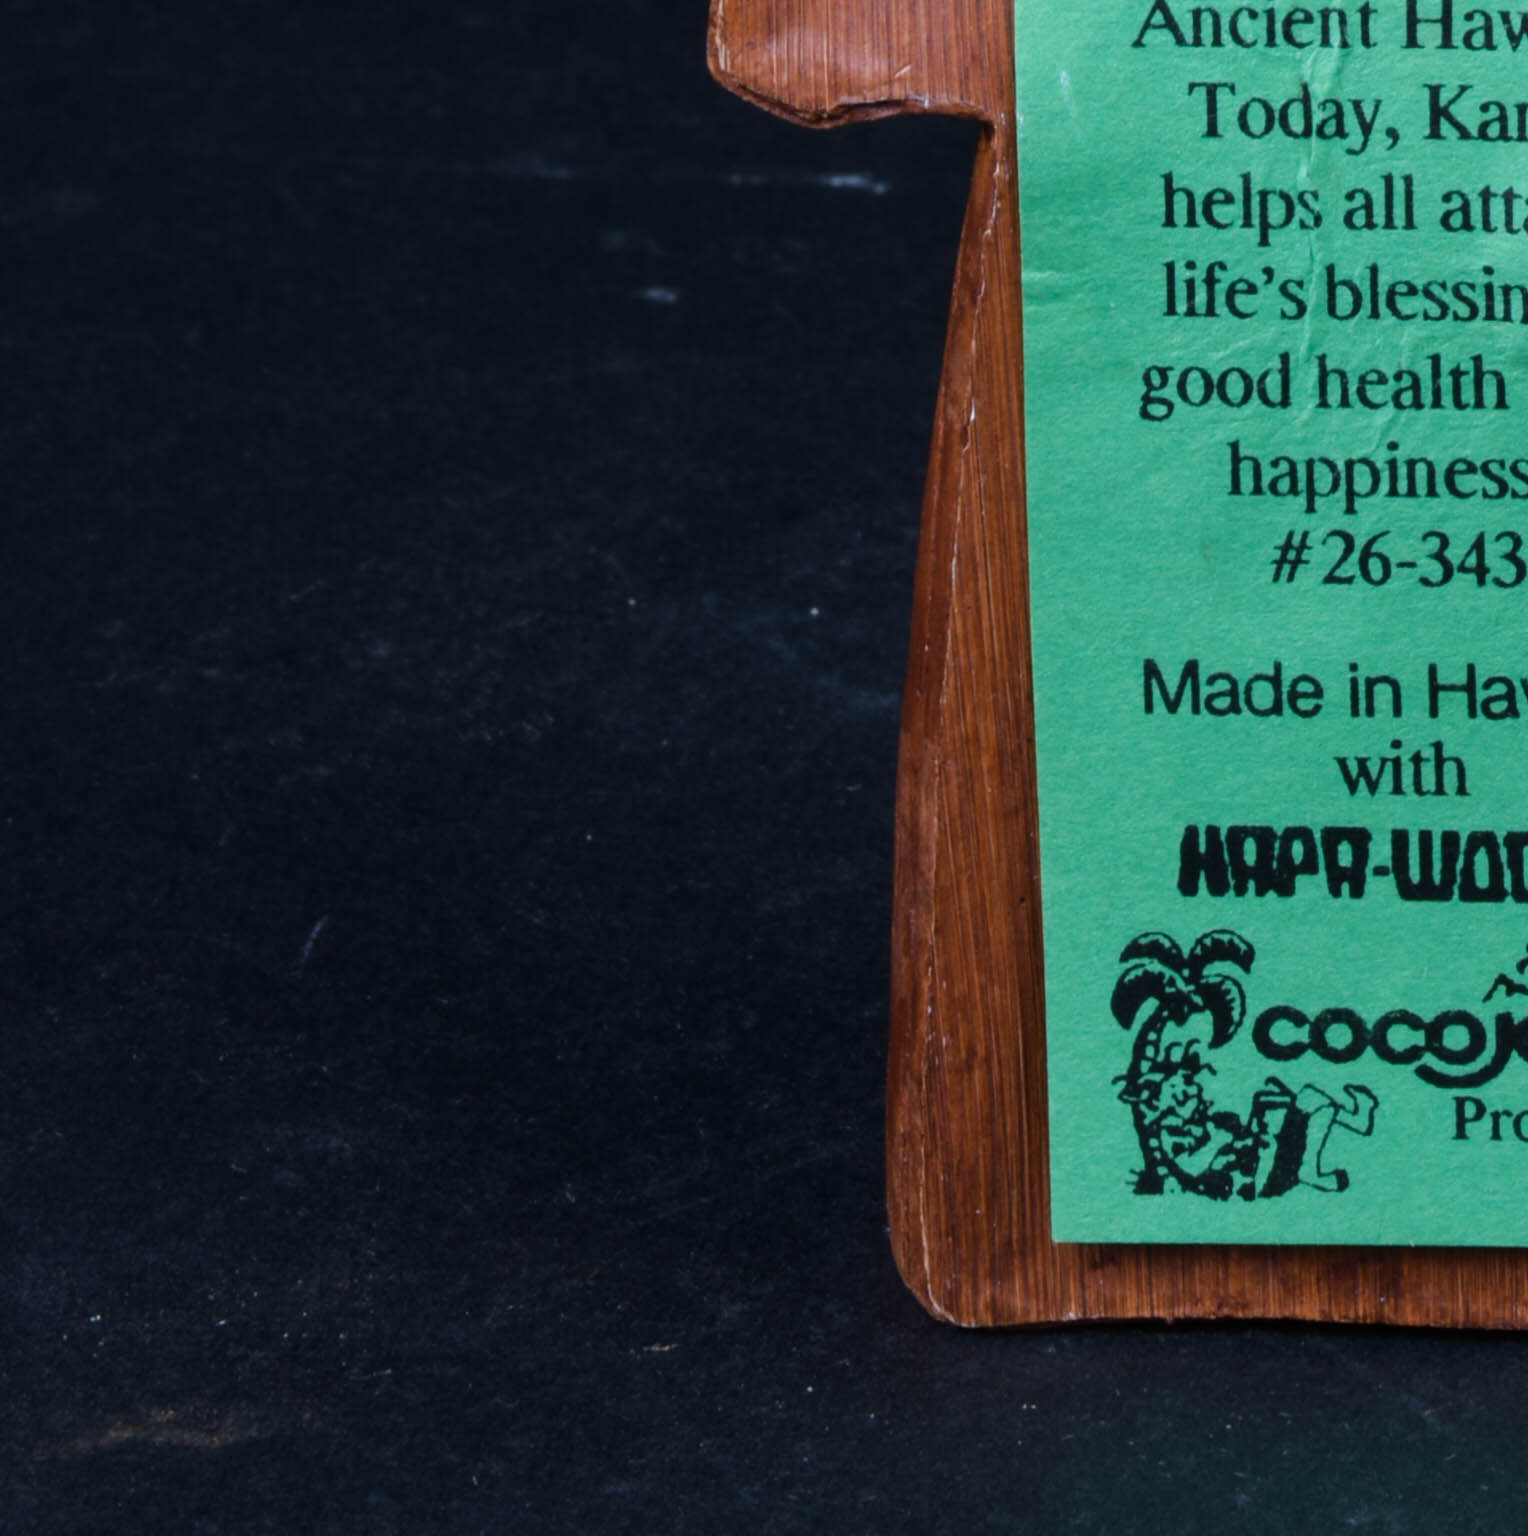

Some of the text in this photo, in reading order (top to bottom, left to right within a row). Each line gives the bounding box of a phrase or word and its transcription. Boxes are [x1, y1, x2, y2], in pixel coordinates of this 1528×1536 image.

[1189, 83, 1399, 155] Today,
[1163, 172, 1322, 247] helps
[1344, 174, 1415, 230] all
[1164, 261, 1306, 320] life's
[1140, 352, 1291, 421] good
[1317, 354, 1509, 410] health
[1144, 659, 1323, 718] Made
[1350, 663, 1402, 717] in
[1335, 739, 1469, 796] with
